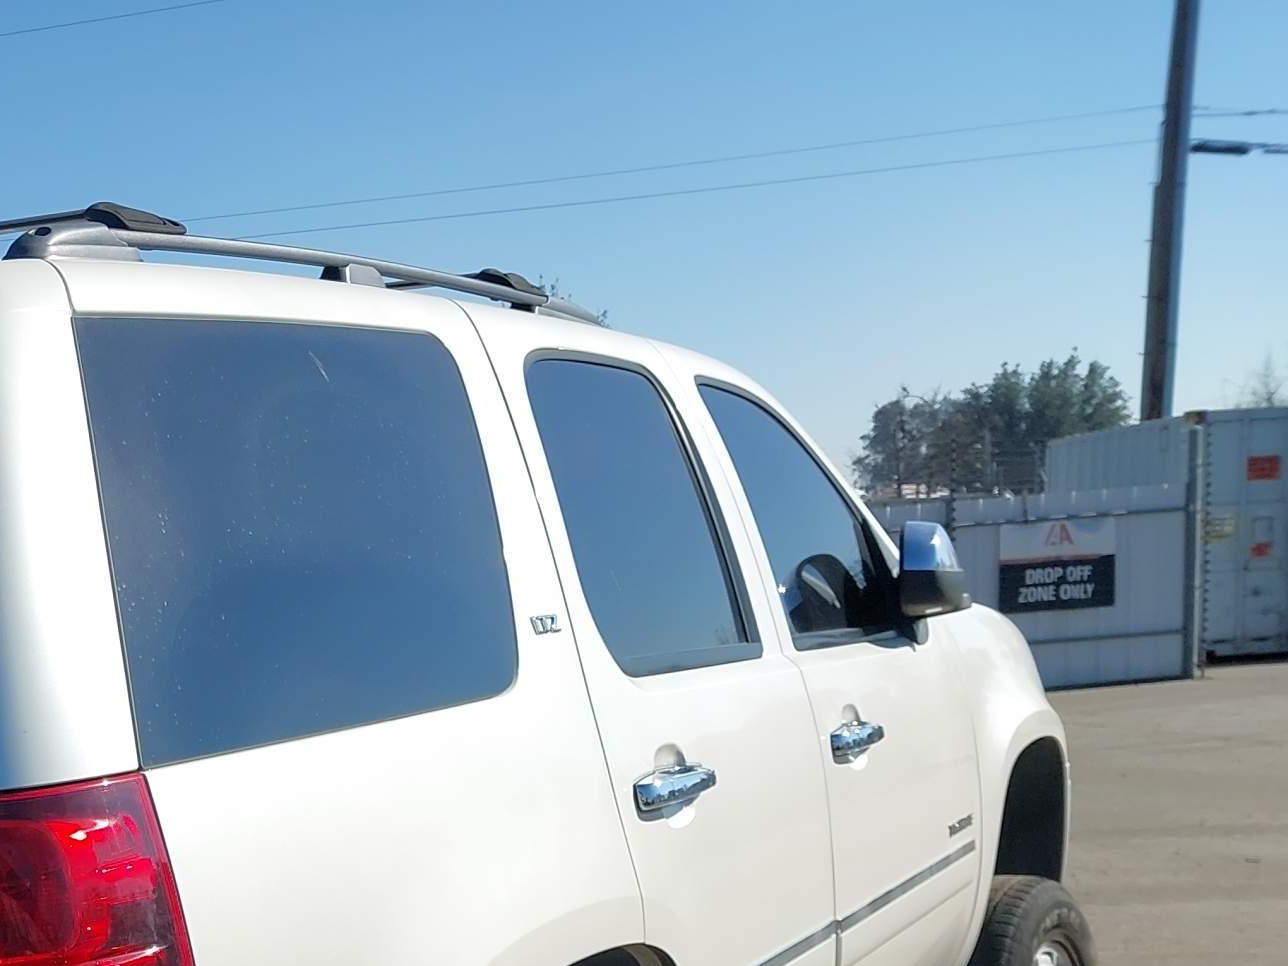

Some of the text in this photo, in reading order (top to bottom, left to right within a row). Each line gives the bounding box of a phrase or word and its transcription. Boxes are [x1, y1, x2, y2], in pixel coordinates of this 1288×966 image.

[1025, 564, 1093, 585] DROP OFF
[1018, 582, 1095, 604] ZONE ONLY
